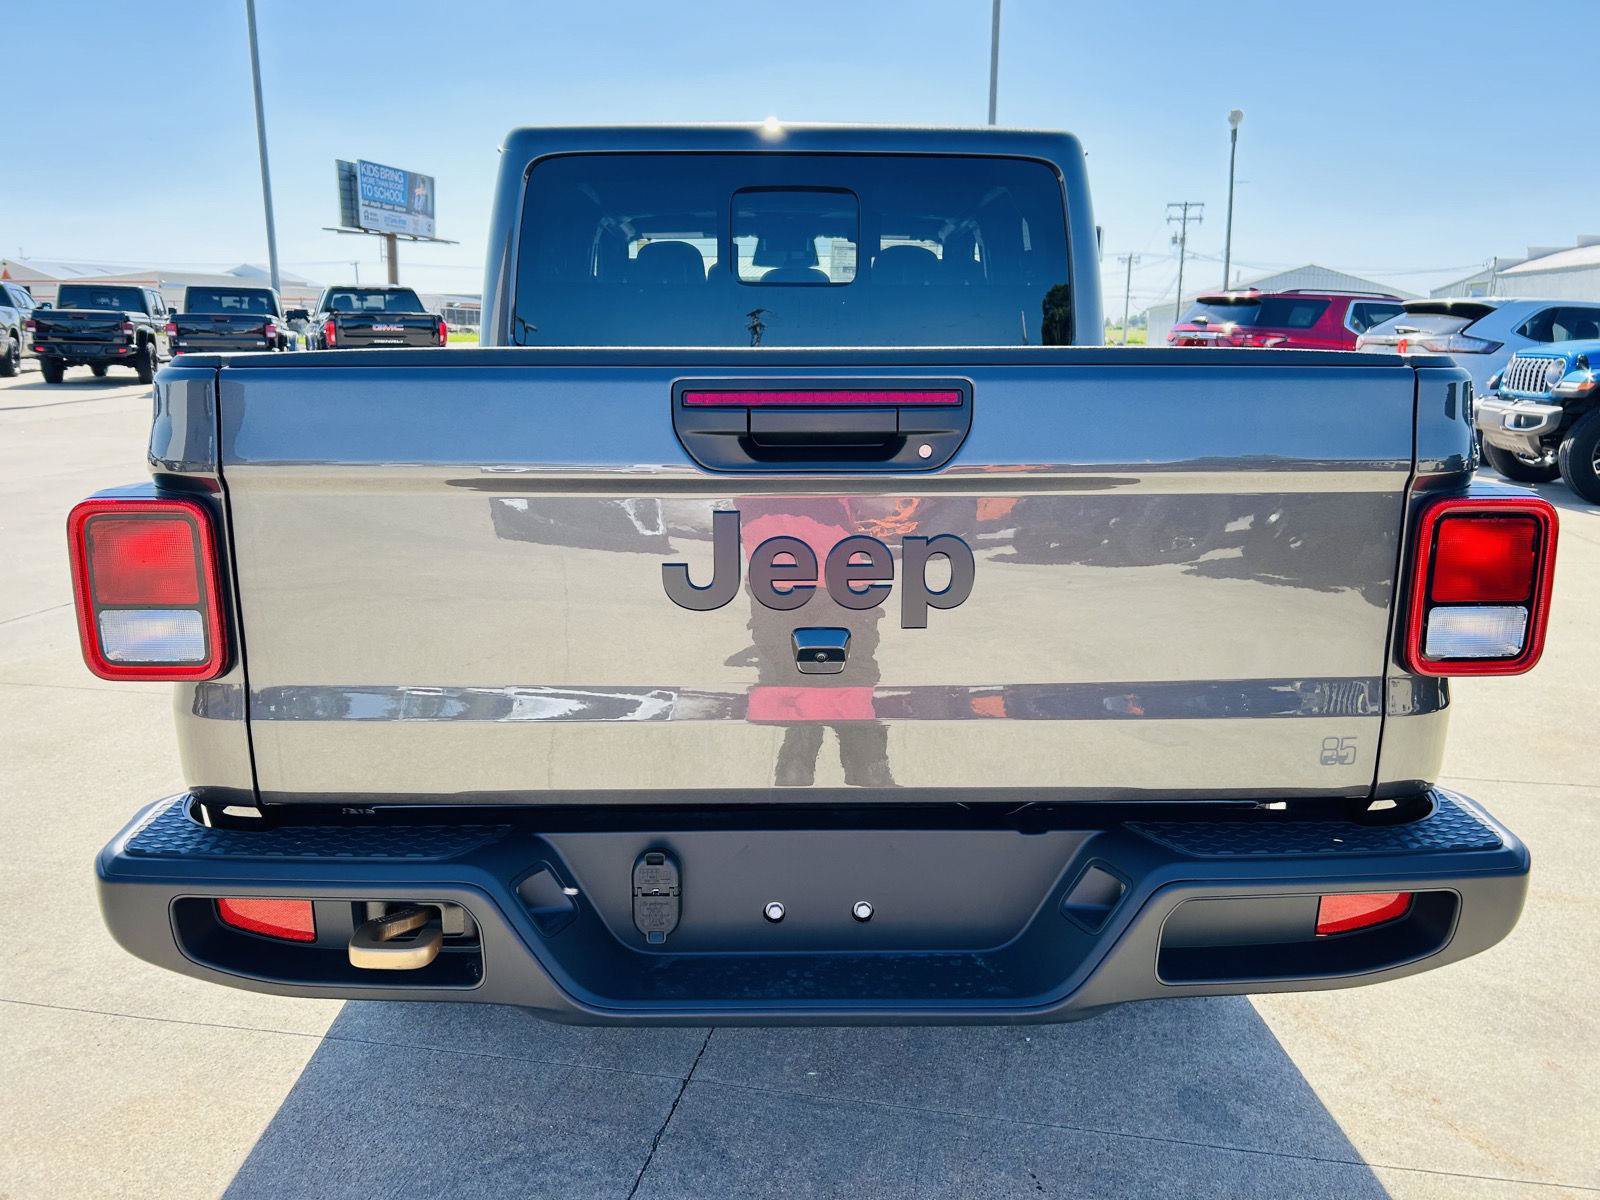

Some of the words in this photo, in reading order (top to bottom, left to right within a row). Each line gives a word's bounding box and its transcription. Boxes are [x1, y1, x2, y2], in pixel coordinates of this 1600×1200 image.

[361, 163, 379, 177] KIDS
[362, 182, 373, 196] TO
[374, 186, 404, 203] SCHOOL
[372, 324, 404, 332] GMC
[662, 510, 975, 629] Jeep
[1320, 736, 1357, 766] 85
